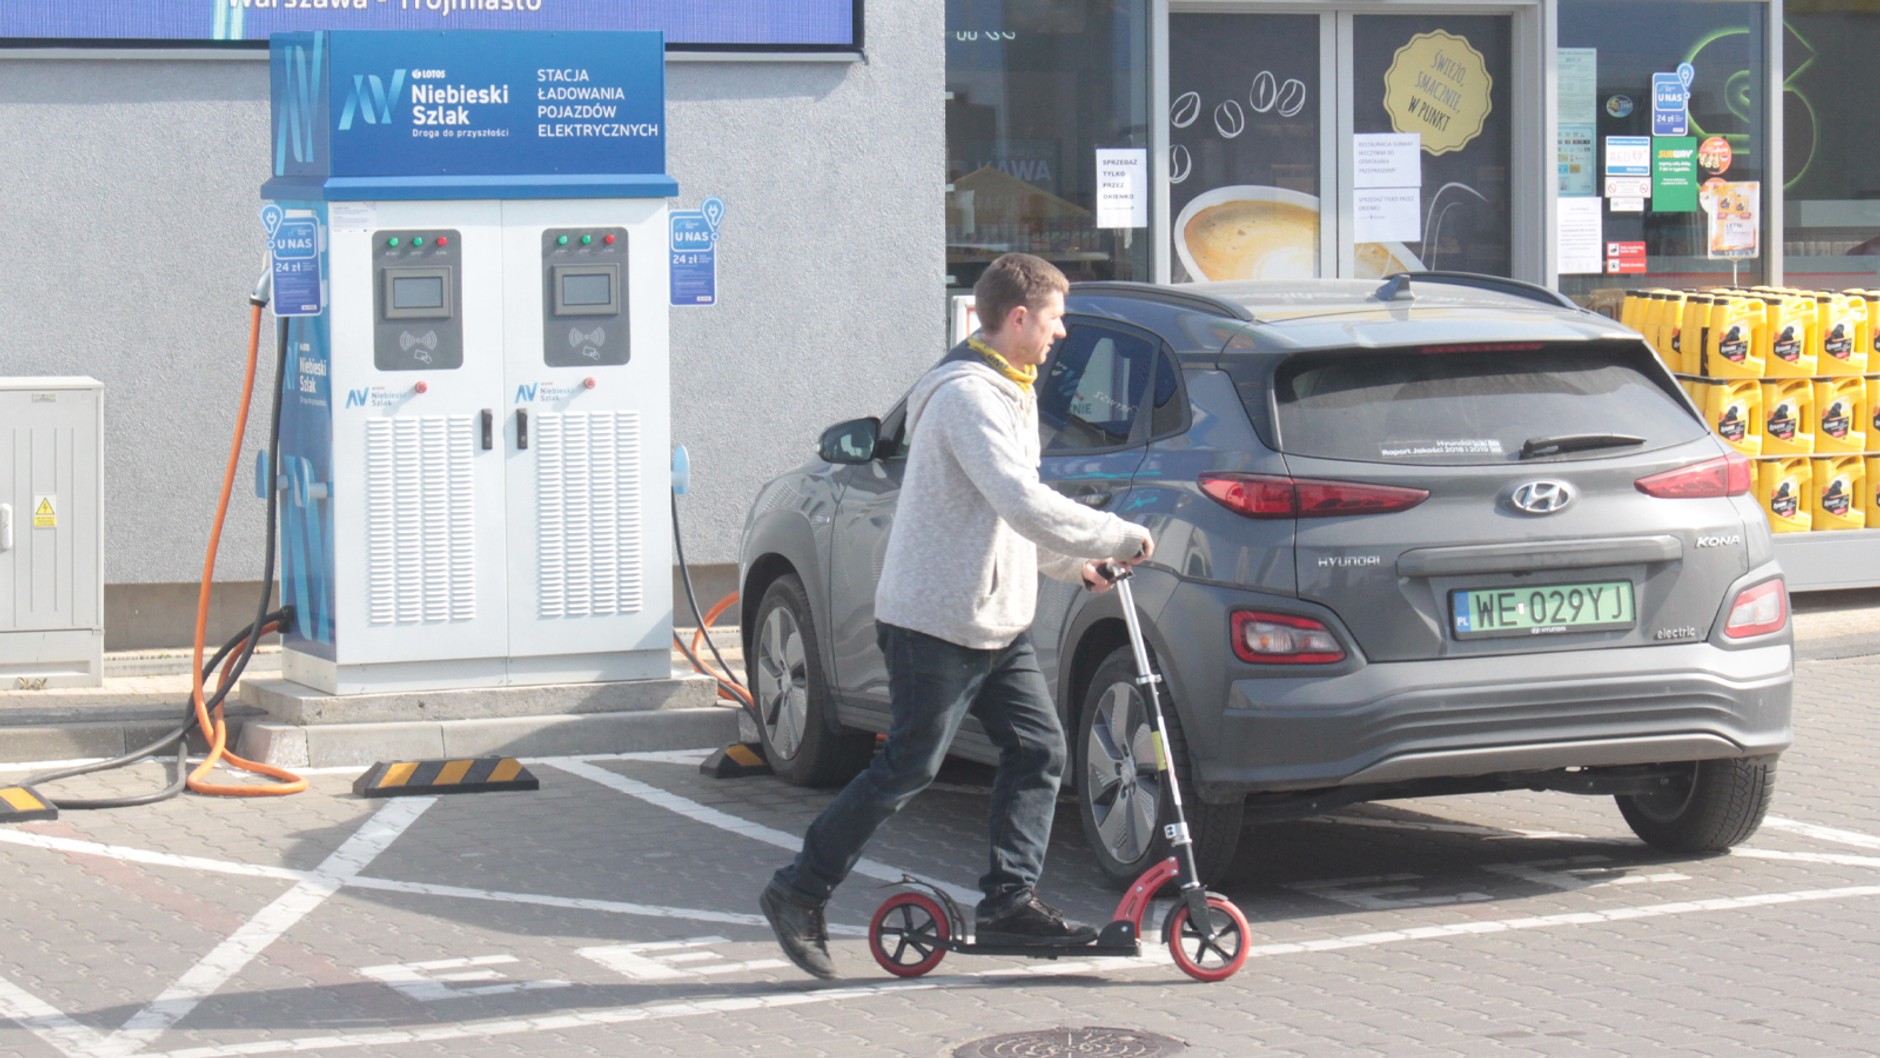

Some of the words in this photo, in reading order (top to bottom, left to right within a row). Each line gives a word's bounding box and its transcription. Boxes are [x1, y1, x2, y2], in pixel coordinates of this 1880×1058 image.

[422, 70, 446, 79] LOTOS
[537, 69, 590, 82] STACJA
[411, 84, 509, 104] Niebieski
[537, 87, 625, 100] ŁADOWANIA
[1665, 93, 1682, 102] NAS
[412, 106, 471, 125] Szlak
[538, 103, 617, 118] POJAZDÓW
[1408, 95, 1421, 114] W
[1418, 101, 1451, 132] PUNKT
[412, 129, 440, 139] Droga
[443, 128, 454, 138] do
[457, 128, 509, 139] przyszłości
[538, 124, 659, 137] ELEKTRYCZNYCH
[675, 232, 683, 242] U
[685, 231, 709, 242] NAS
[277, 239, 286, 249] U
[288, 238, 313, 249] NAS
[673, 254, 687, 265] 24
[275, 263, 289, 273] 24
[1695, 534, 1742, 549] KONA
[1318, 555, 1380, 568] HYUNDAI
[1475, 592, 1518, 629] WE
[1529, 585, 1624, 625] 029YJ
[1457, 616, 1469, 627] PL
[1656, 626, 1696, 640] electric
